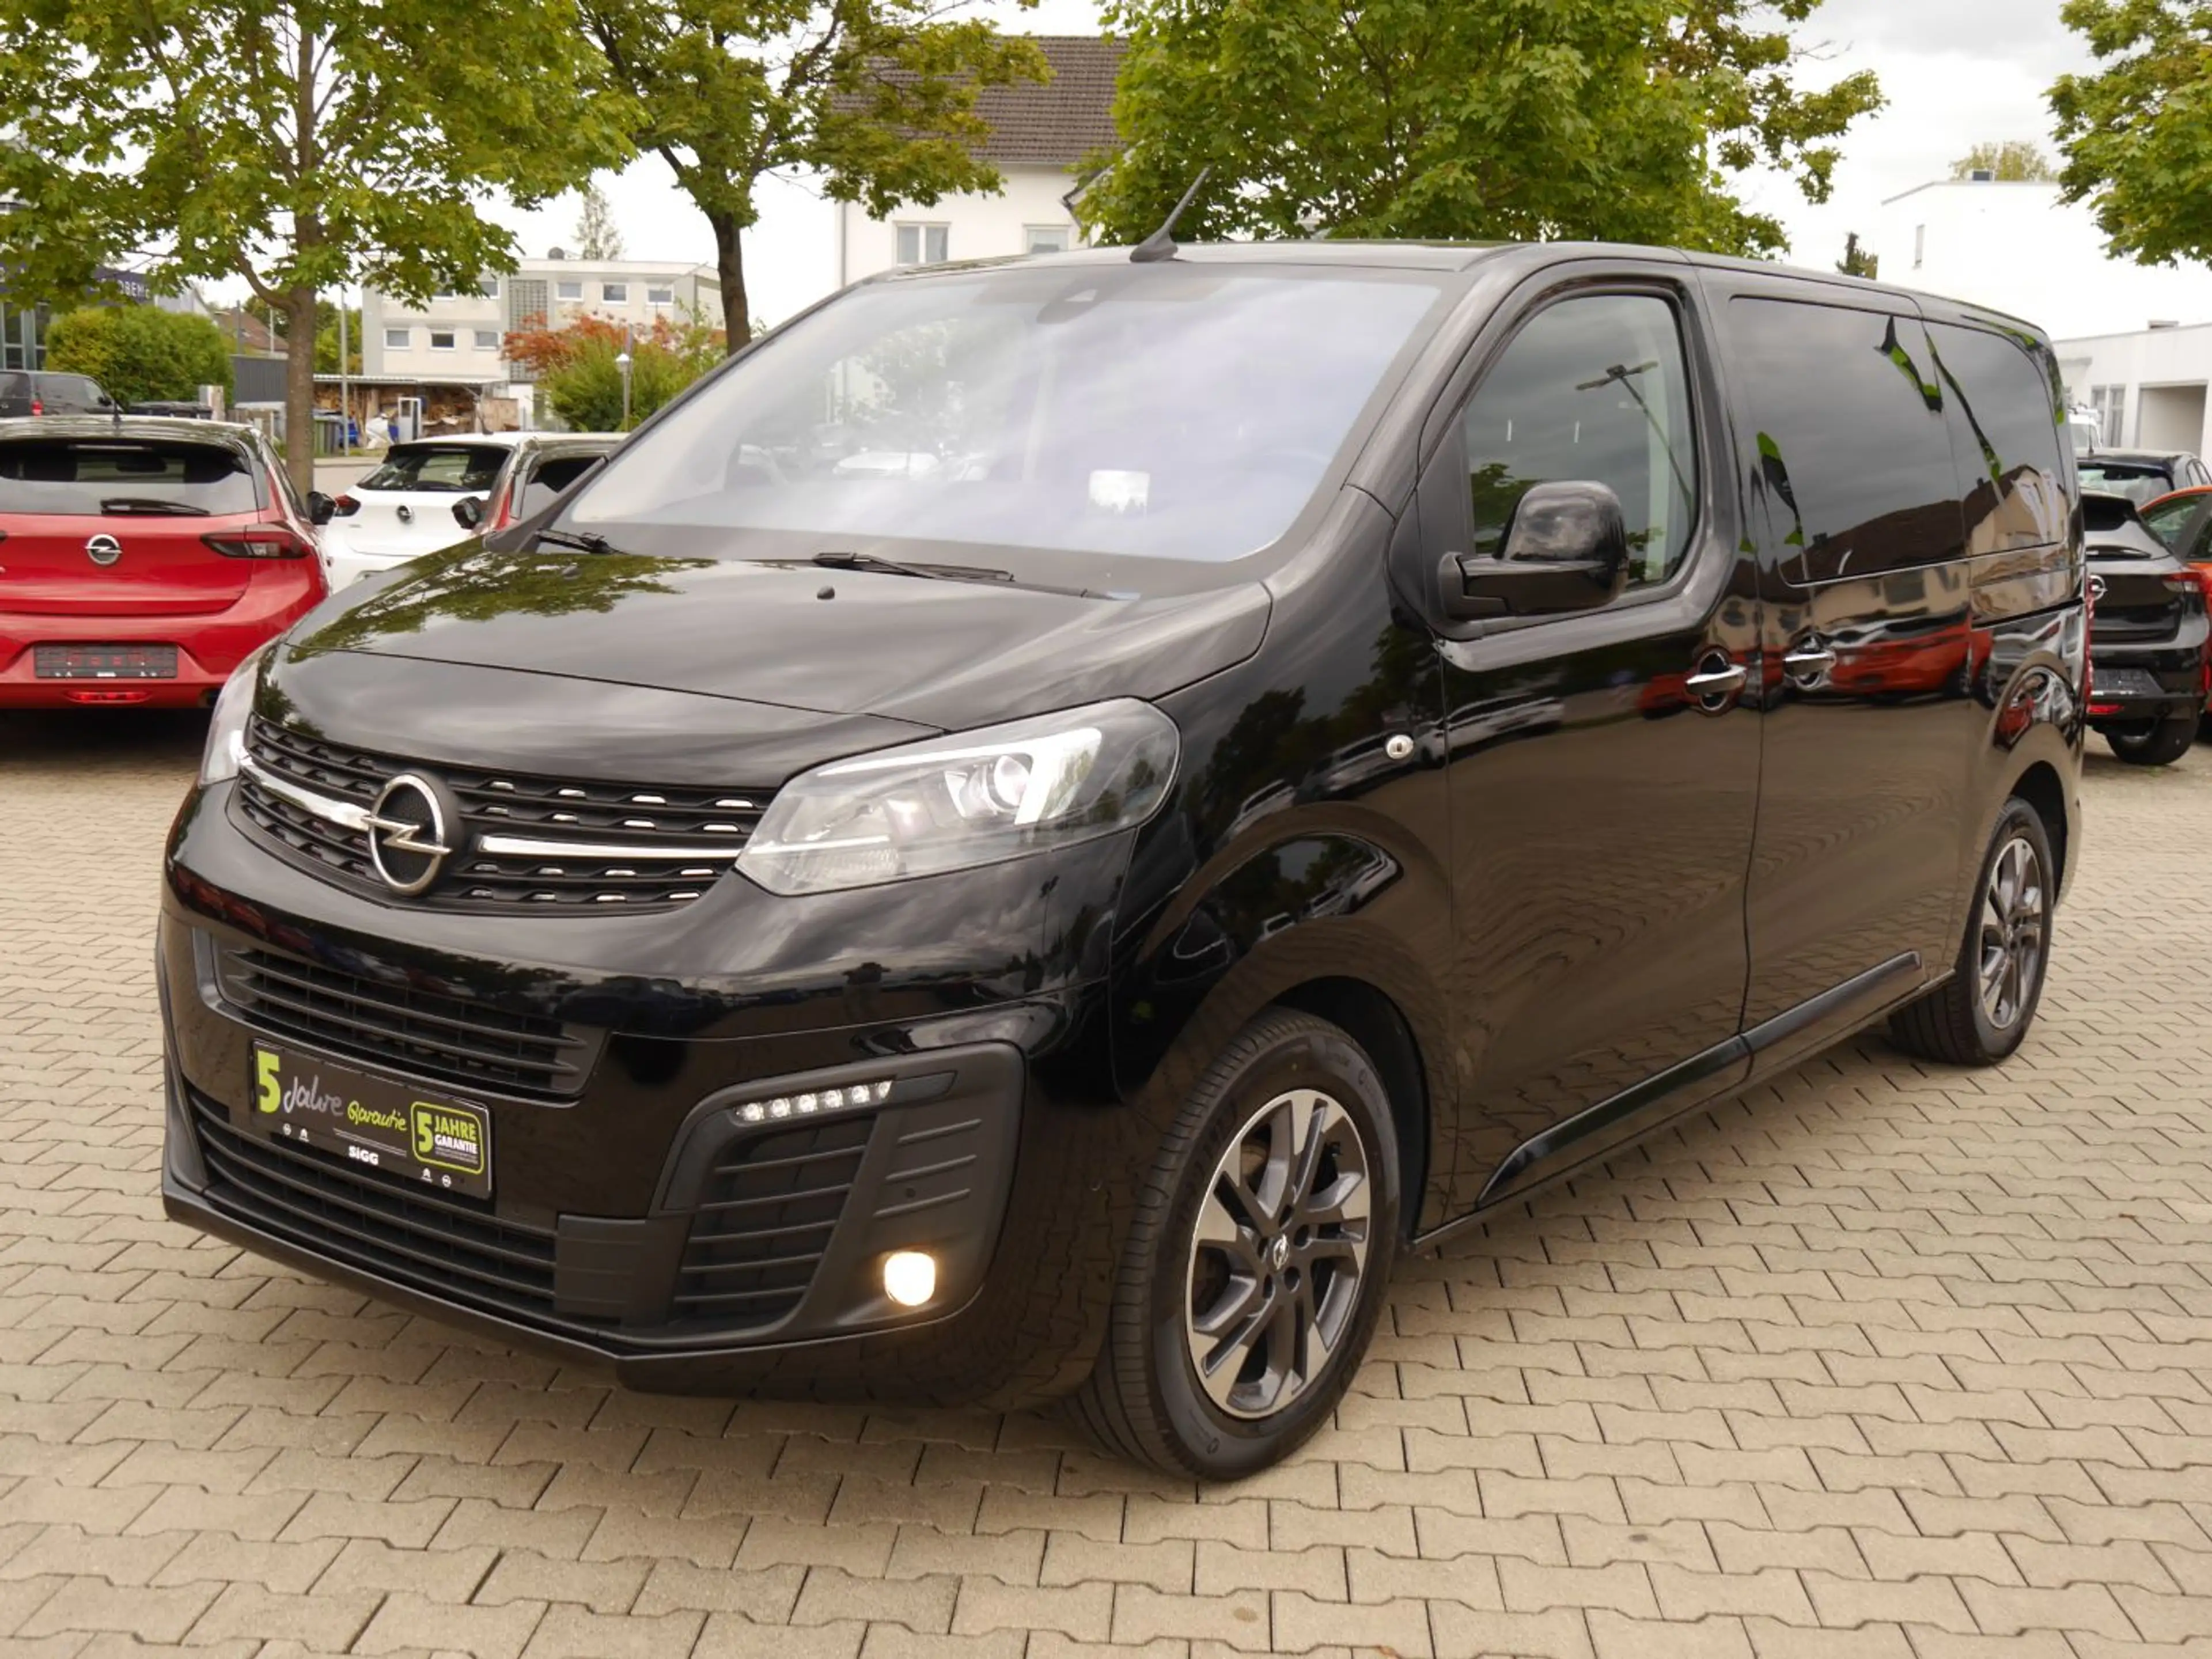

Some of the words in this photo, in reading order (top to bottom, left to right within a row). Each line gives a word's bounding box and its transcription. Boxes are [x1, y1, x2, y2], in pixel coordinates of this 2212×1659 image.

[257, 1050, 281, 1113] 5
[283, 1075, 343, 1117] Jahre
[347, 1100, 407, 1131] Garantie
[417, 1111, 433, 1153] 5
[435, 1115, 476, 1142] JAHRE
[435, 1134, 478, 1154] GARANTIE
